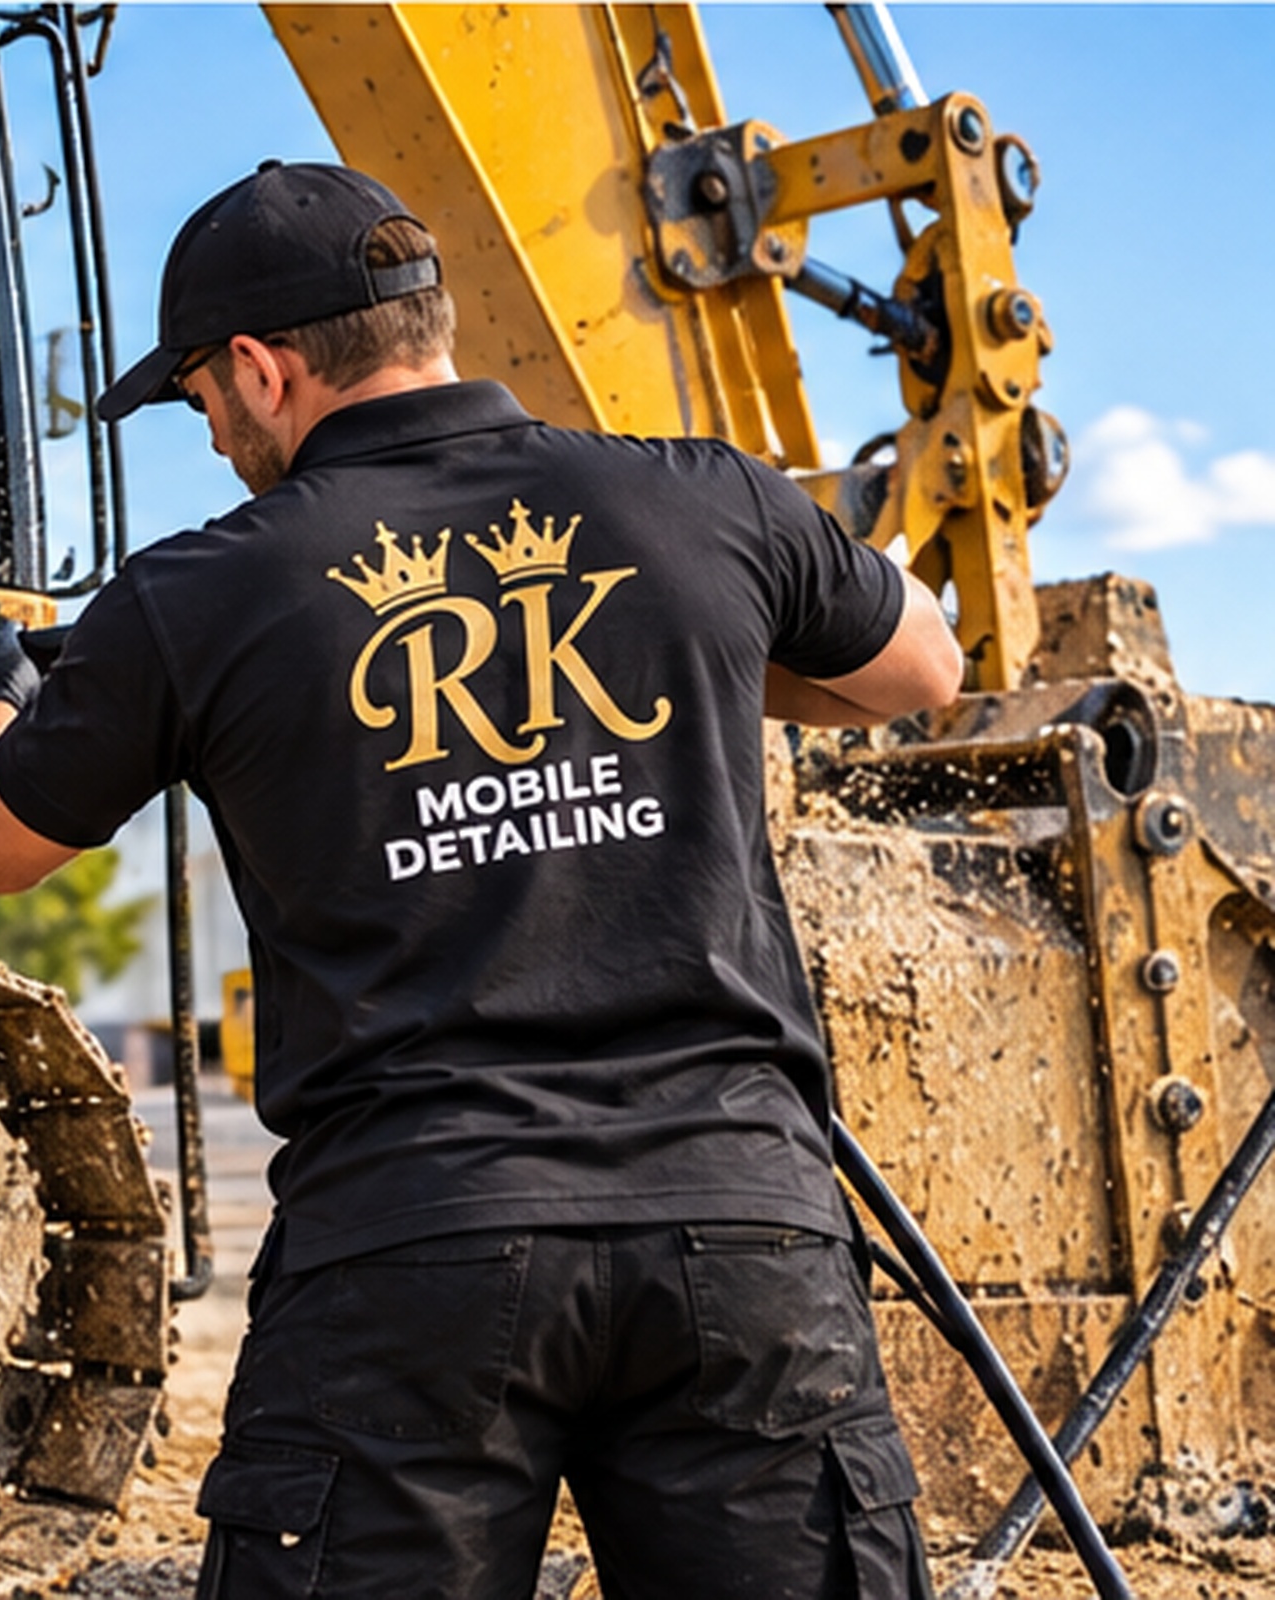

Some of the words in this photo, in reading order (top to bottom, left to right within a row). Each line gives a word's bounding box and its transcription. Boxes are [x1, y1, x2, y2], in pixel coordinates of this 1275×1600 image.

[349, 566, 673, 771] RK
[416, 753, 622, 827] MOBILE
[384, 797, 665, 881] DETAILING
